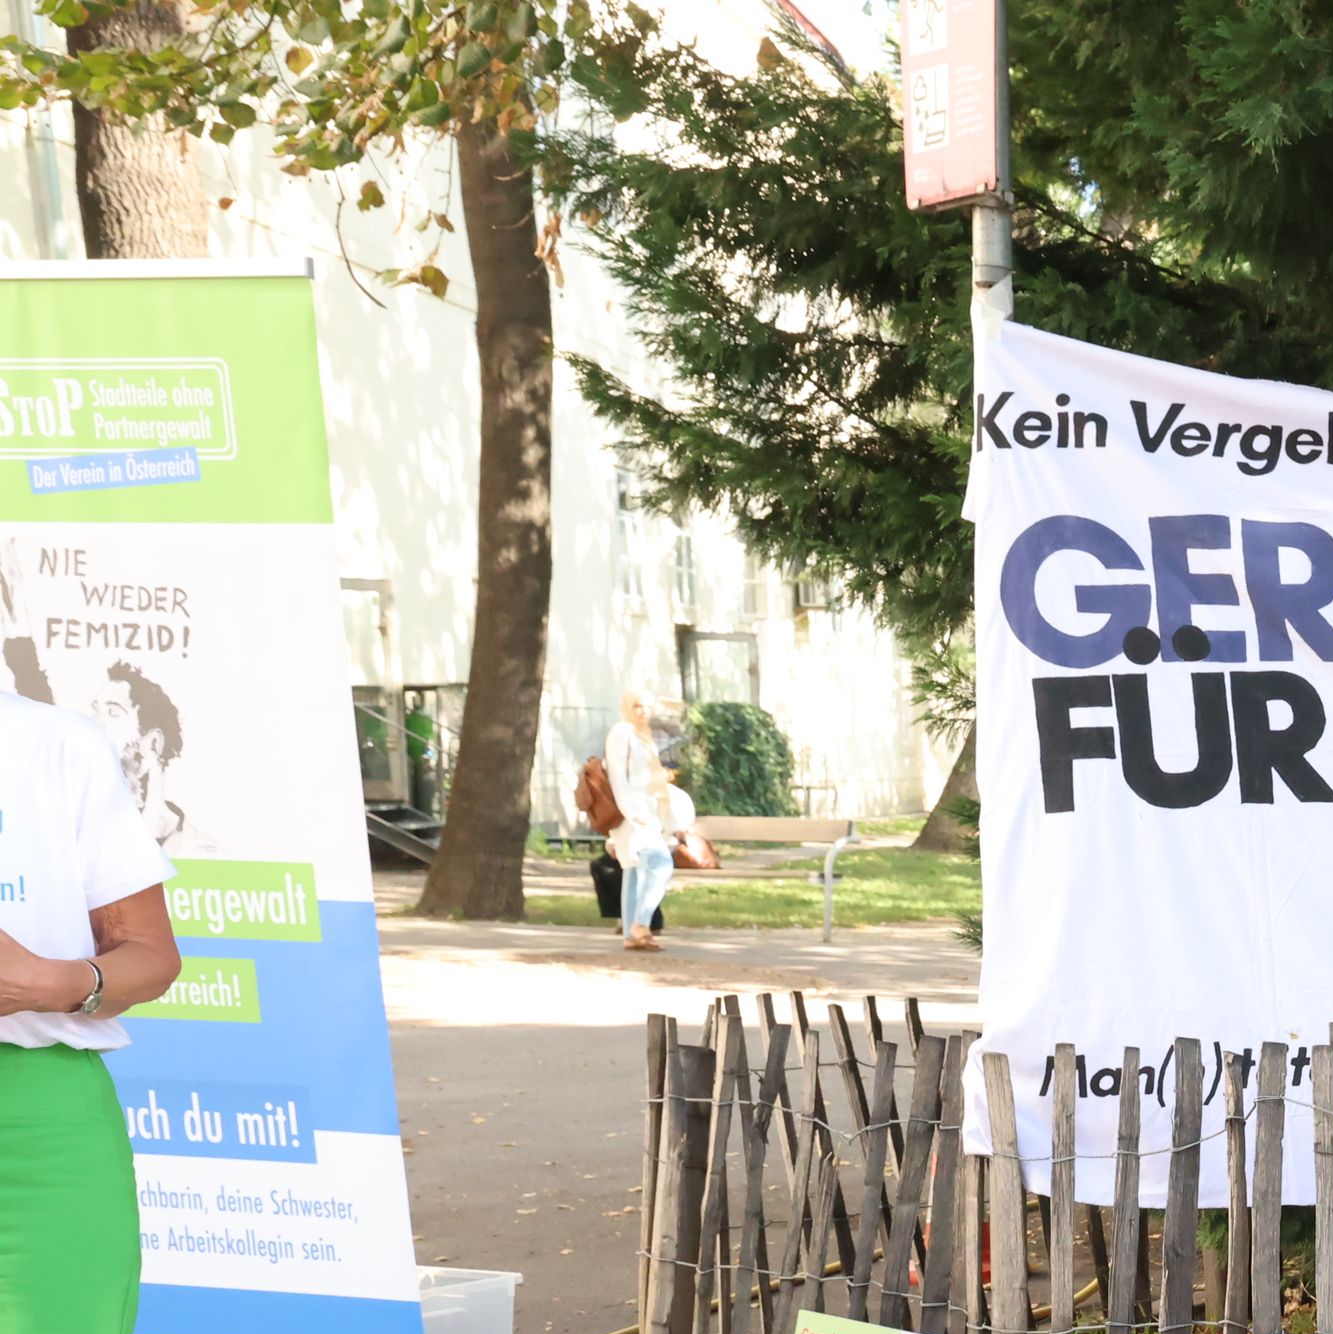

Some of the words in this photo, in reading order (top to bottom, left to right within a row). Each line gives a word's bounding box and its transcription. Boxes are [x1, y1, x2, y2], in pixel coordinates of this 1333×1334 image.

[88, 377, 167, 407] Stadtteile
[172, 377, 214, 407] ohne
[93, 410, 212, 446] Partnergewalt
[975, 391, 1107, 454] Kein
[33, 465, 57, 488] Der
[60, 462, 105, 485] Verein
[109, 461, 122, 482] in
[126, 451, 196, 481] Österreich
[39, 547, 87, 577] NIE
[80, 581, 190, 618] WIEDER
[45, 617, 191, 658] FEMIZID!
[183, 1091, 223, 1144] du
[237, 1100, 300, 1149] mit!
[216, 1185, 263, 1214] deine
[270, 1189, 359, 1225] Schwester,
[168, 1226, 294, 1264] Arbeitskollegin
[303, 1238, 342, 1262] sein.
